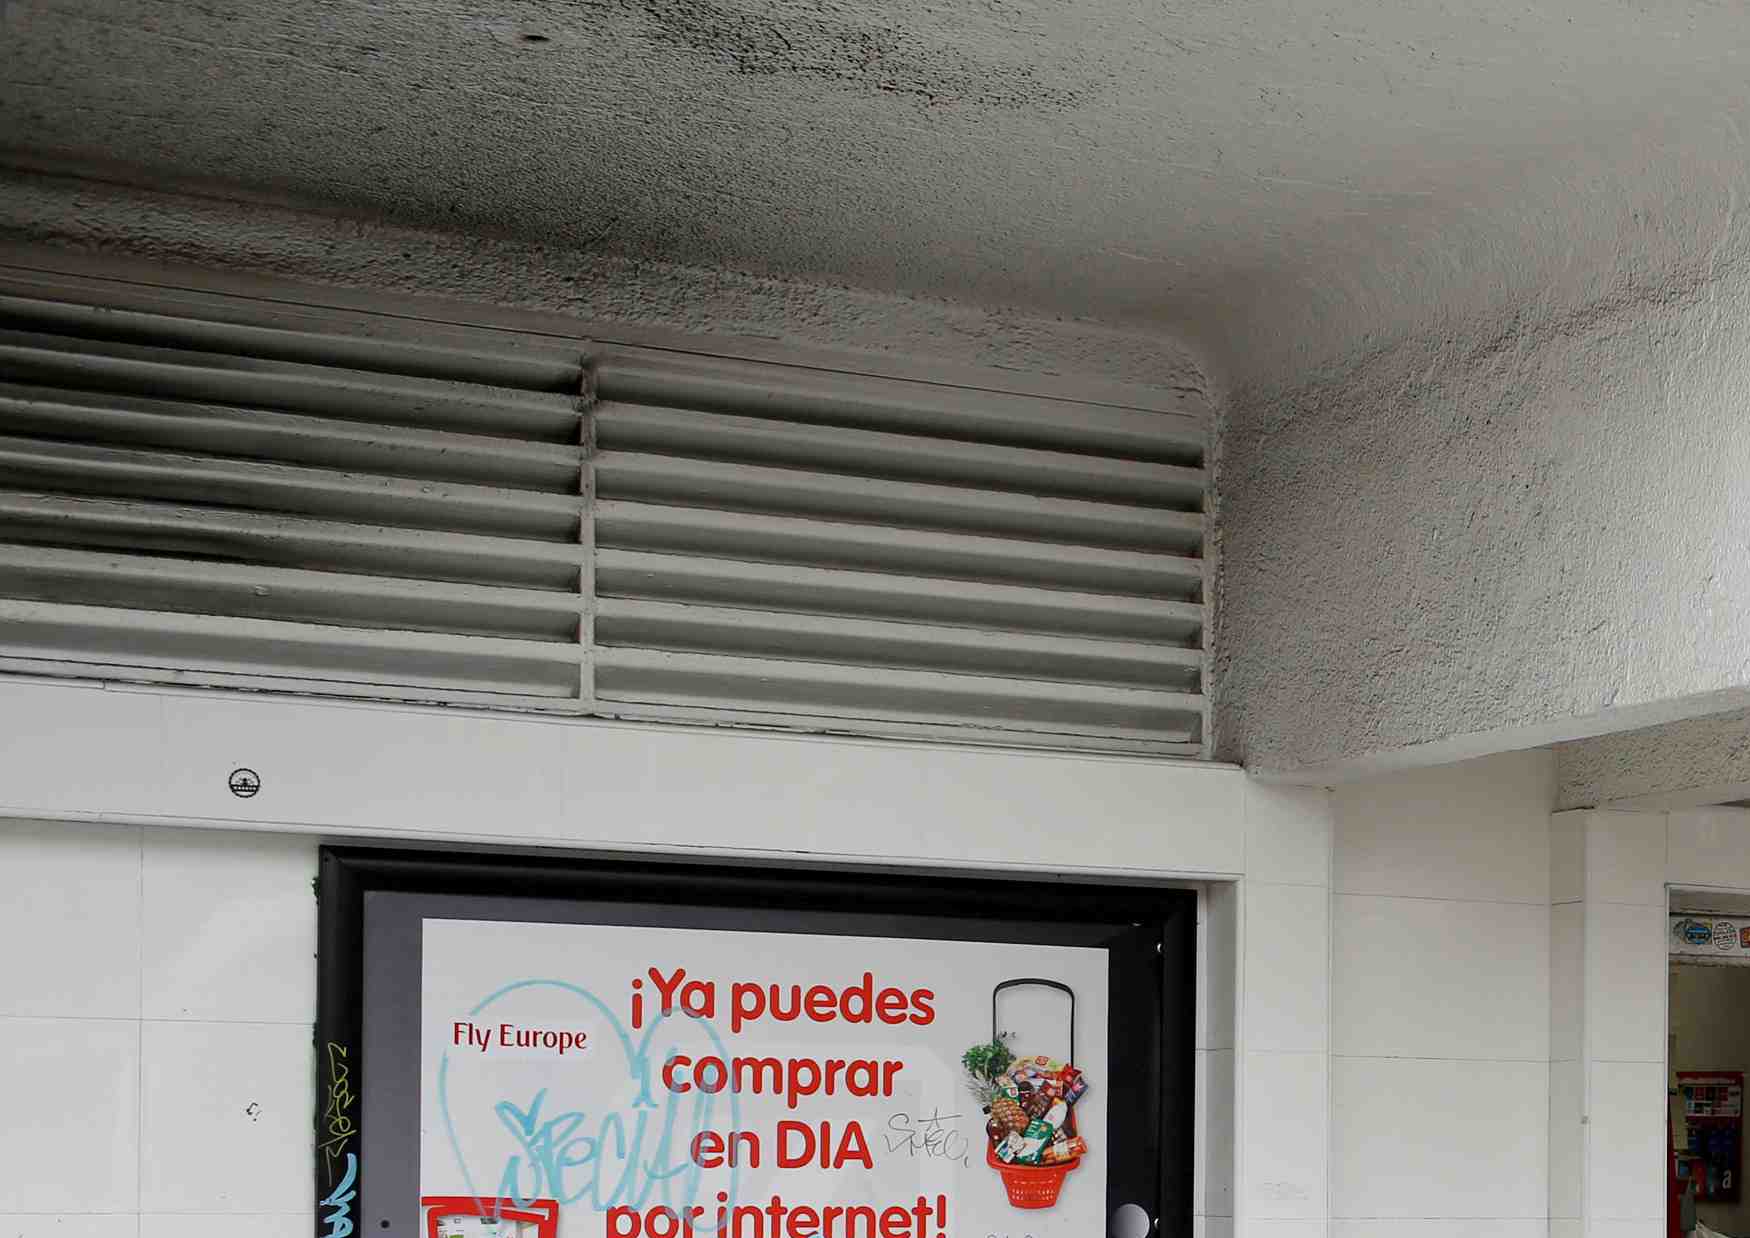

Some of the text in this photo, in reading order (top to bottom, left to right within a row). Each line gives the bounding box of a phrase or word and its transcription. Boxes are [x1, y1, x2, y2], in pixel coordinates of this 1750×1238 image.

[631, 967, 935, 1033] ¡Ya puedes
[453, 1022, 587, 1055] Fly Europe
[662, 1055, 903, 1108] comprar
[690, 1130, 760, 1170] en
[776, 1120, 874, 1170] DIA
